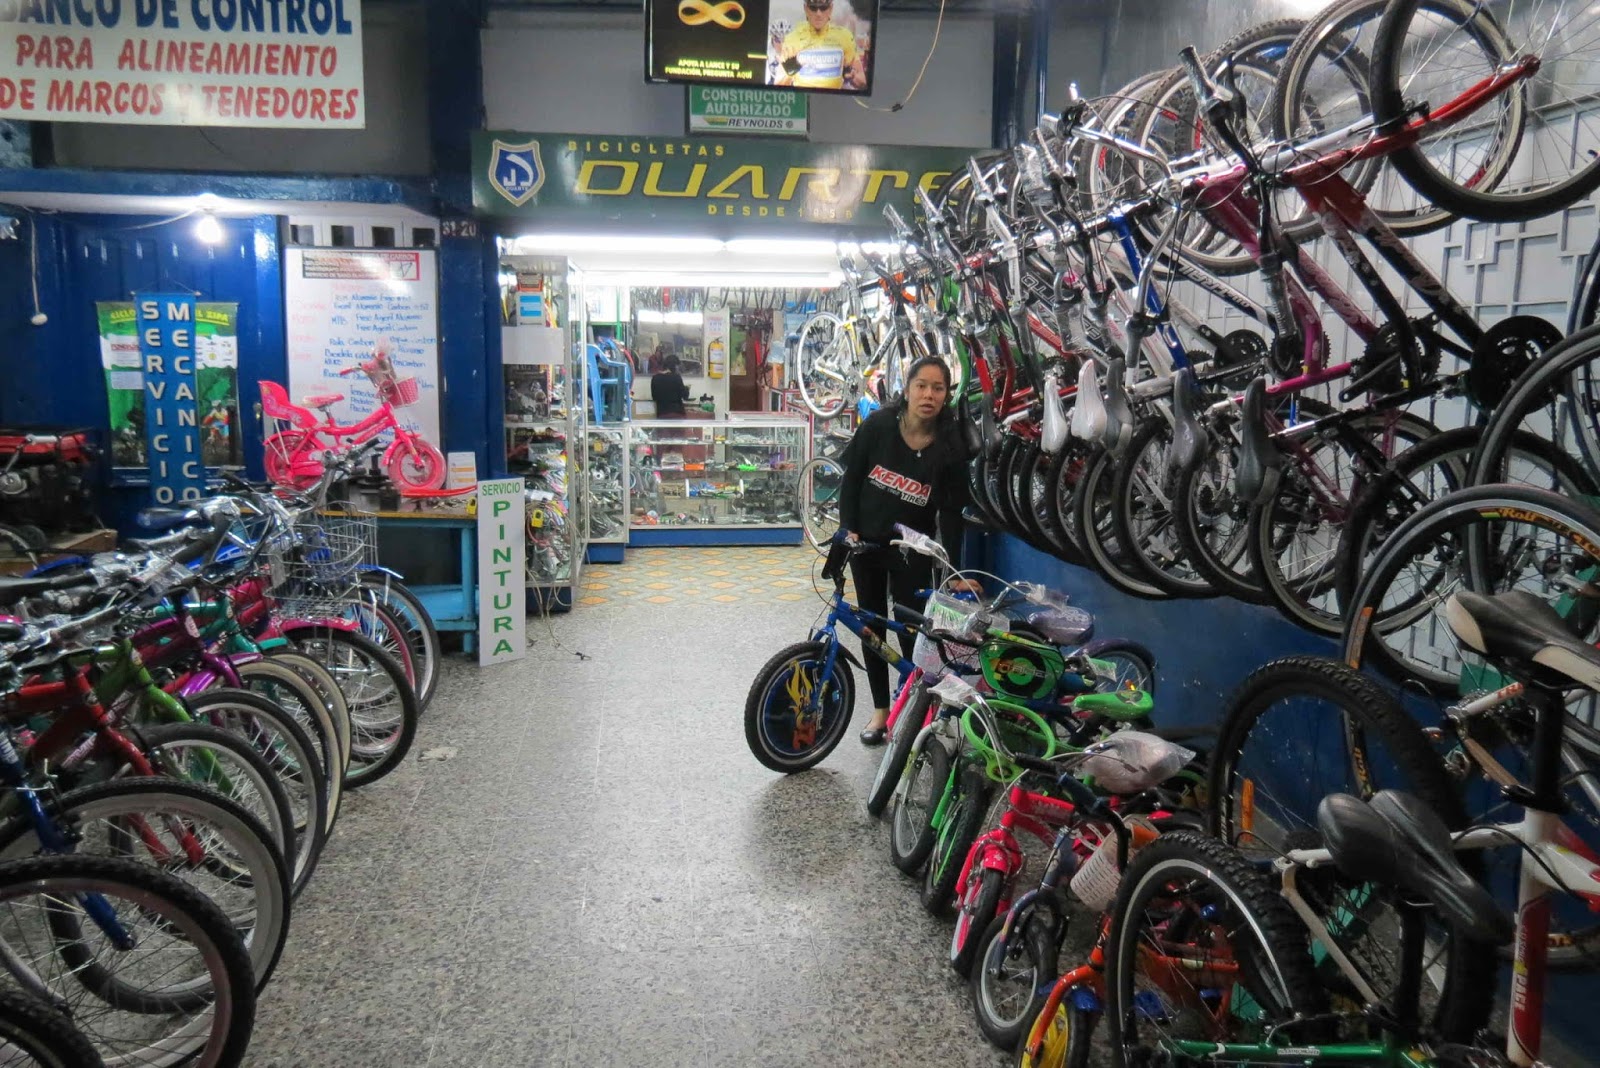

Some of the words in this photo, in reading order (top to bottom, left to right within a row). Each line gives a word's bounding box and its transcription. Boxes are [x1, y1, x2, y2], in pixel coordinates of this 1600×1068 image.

[135, 0, 179, 28] DE
[191, 0, 353, 35] CONTROL
[16, 34, 93, 71] PARA
[118, 38, 337, 77] ALINEAMIENTO
[0, 77, 36, 110] DE
[47, 79, 166, 116] MARCOS
[202, 85, 359, 122] TENEDORES
[702, 88, 796, 104] CONSTRUCTOR
[705, 101, 792, 117] AUTORIZADO
[728, 118, 783, 129] REYNOLDS
[568, 140, 724, 156] BICICLETAS
[707, 204, 785, 217] DESDE
[140, 300, 174, 505] SERVICIO
[167, 302, 201, 501] MECANICO
[481, 481, 521, 497] SERVICIO
[868, 465, 932, 498] KENDA
[901, 492, 927, 507] TIRES
[493, 500, 514, 656] PINTURA
